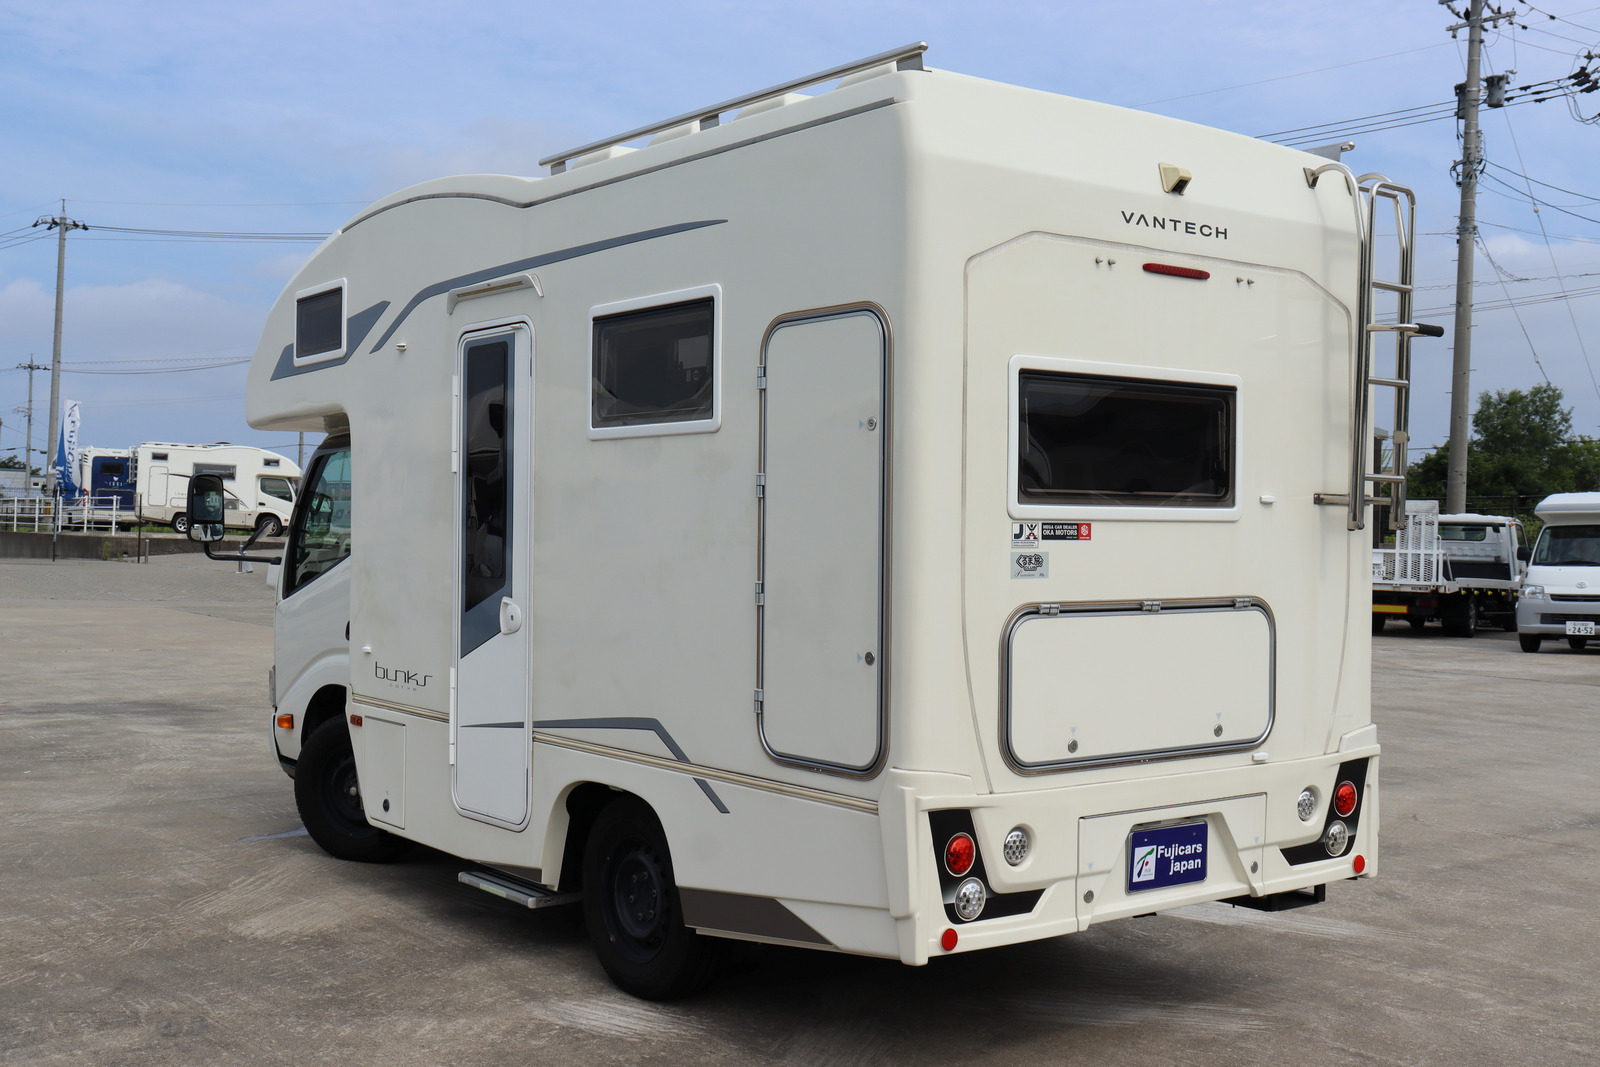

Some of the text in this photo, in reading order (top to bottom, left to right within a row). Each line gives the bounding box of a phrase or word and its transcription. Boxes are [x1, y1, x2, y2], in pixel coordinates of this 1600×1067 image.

[1121, 211, 1227, 240] VANTECH
[375, 661, 433, 687] bunks
[1157, 843, 1203, 860] Fujicars
[1169, 858, 1202, 876] japan
